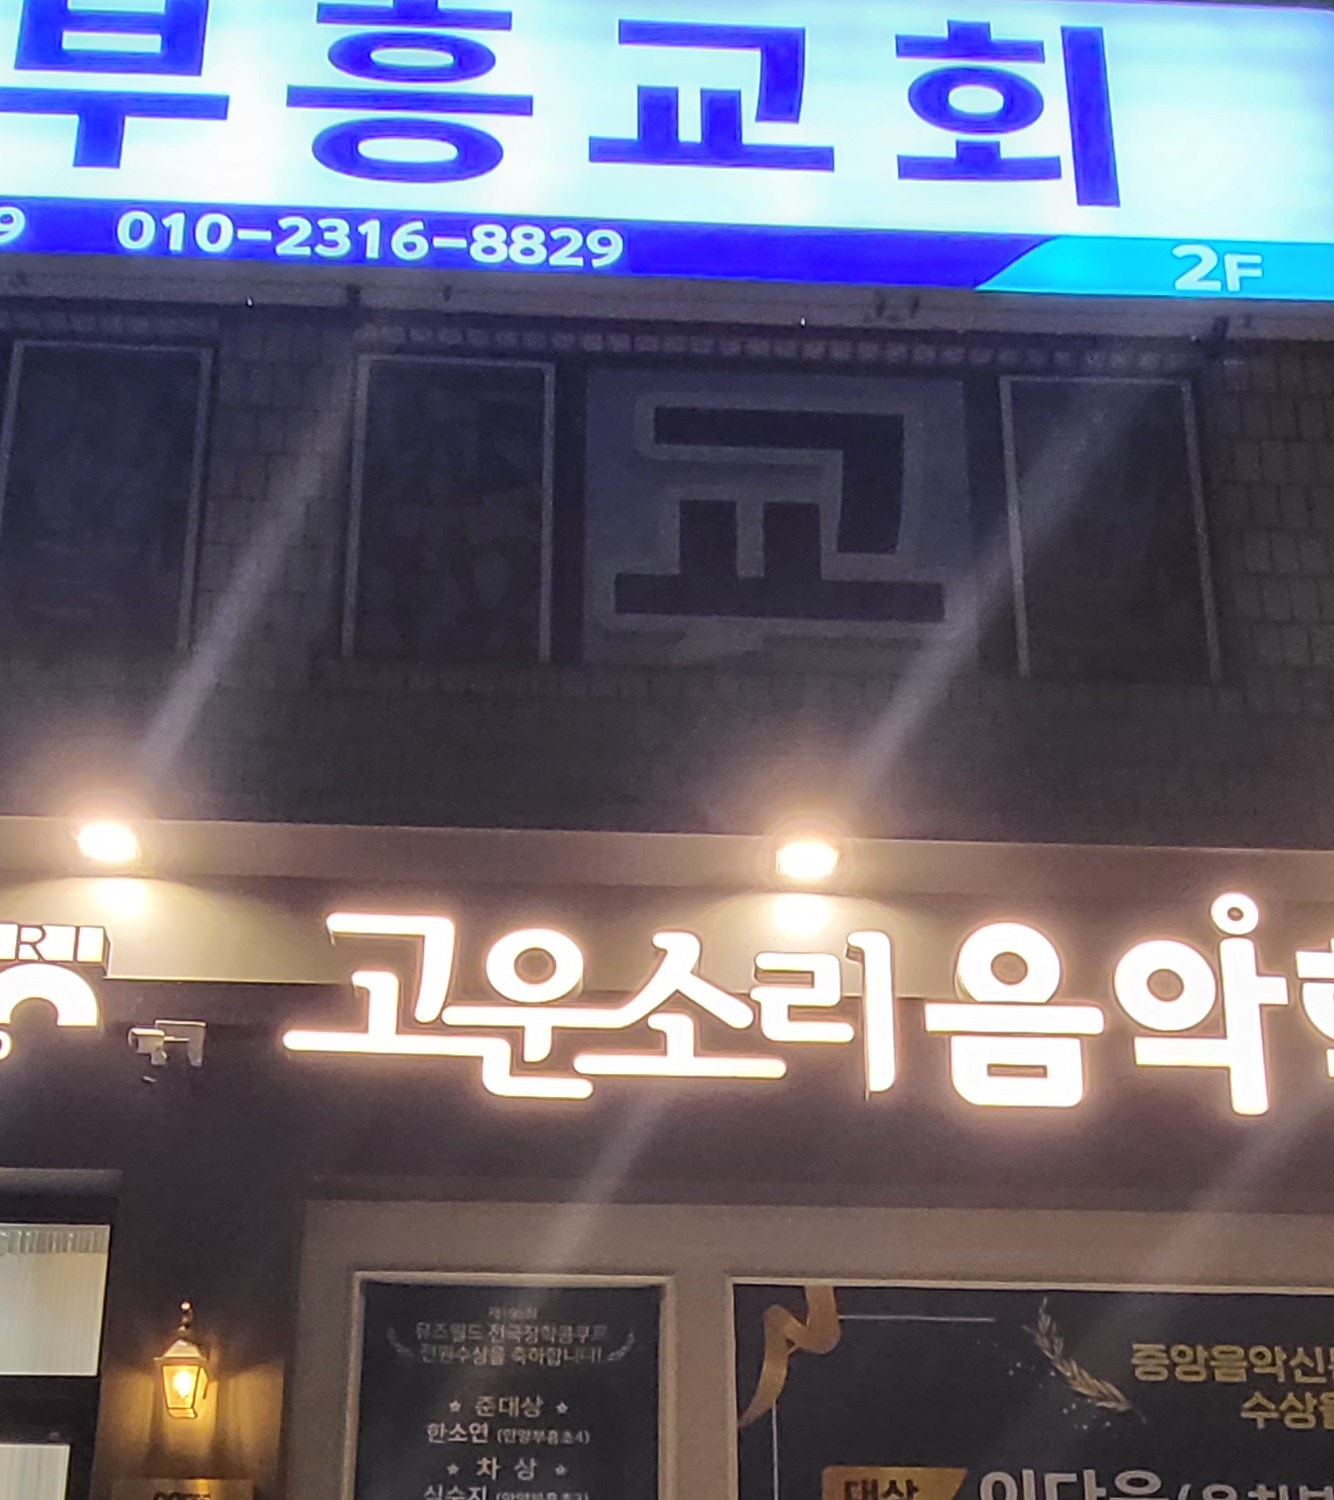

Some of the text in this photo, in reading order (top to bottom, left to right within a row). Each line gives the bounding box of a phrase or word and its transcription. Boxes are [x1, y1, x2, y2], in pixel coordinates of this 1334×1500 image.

[115, 208, 624, 268] 010-2316-8829
[1173, 243, 1265, 293] 2F
[475, 1396, 544, 1418] 준대상
[426, 1422, 490, 1444] 한소연
